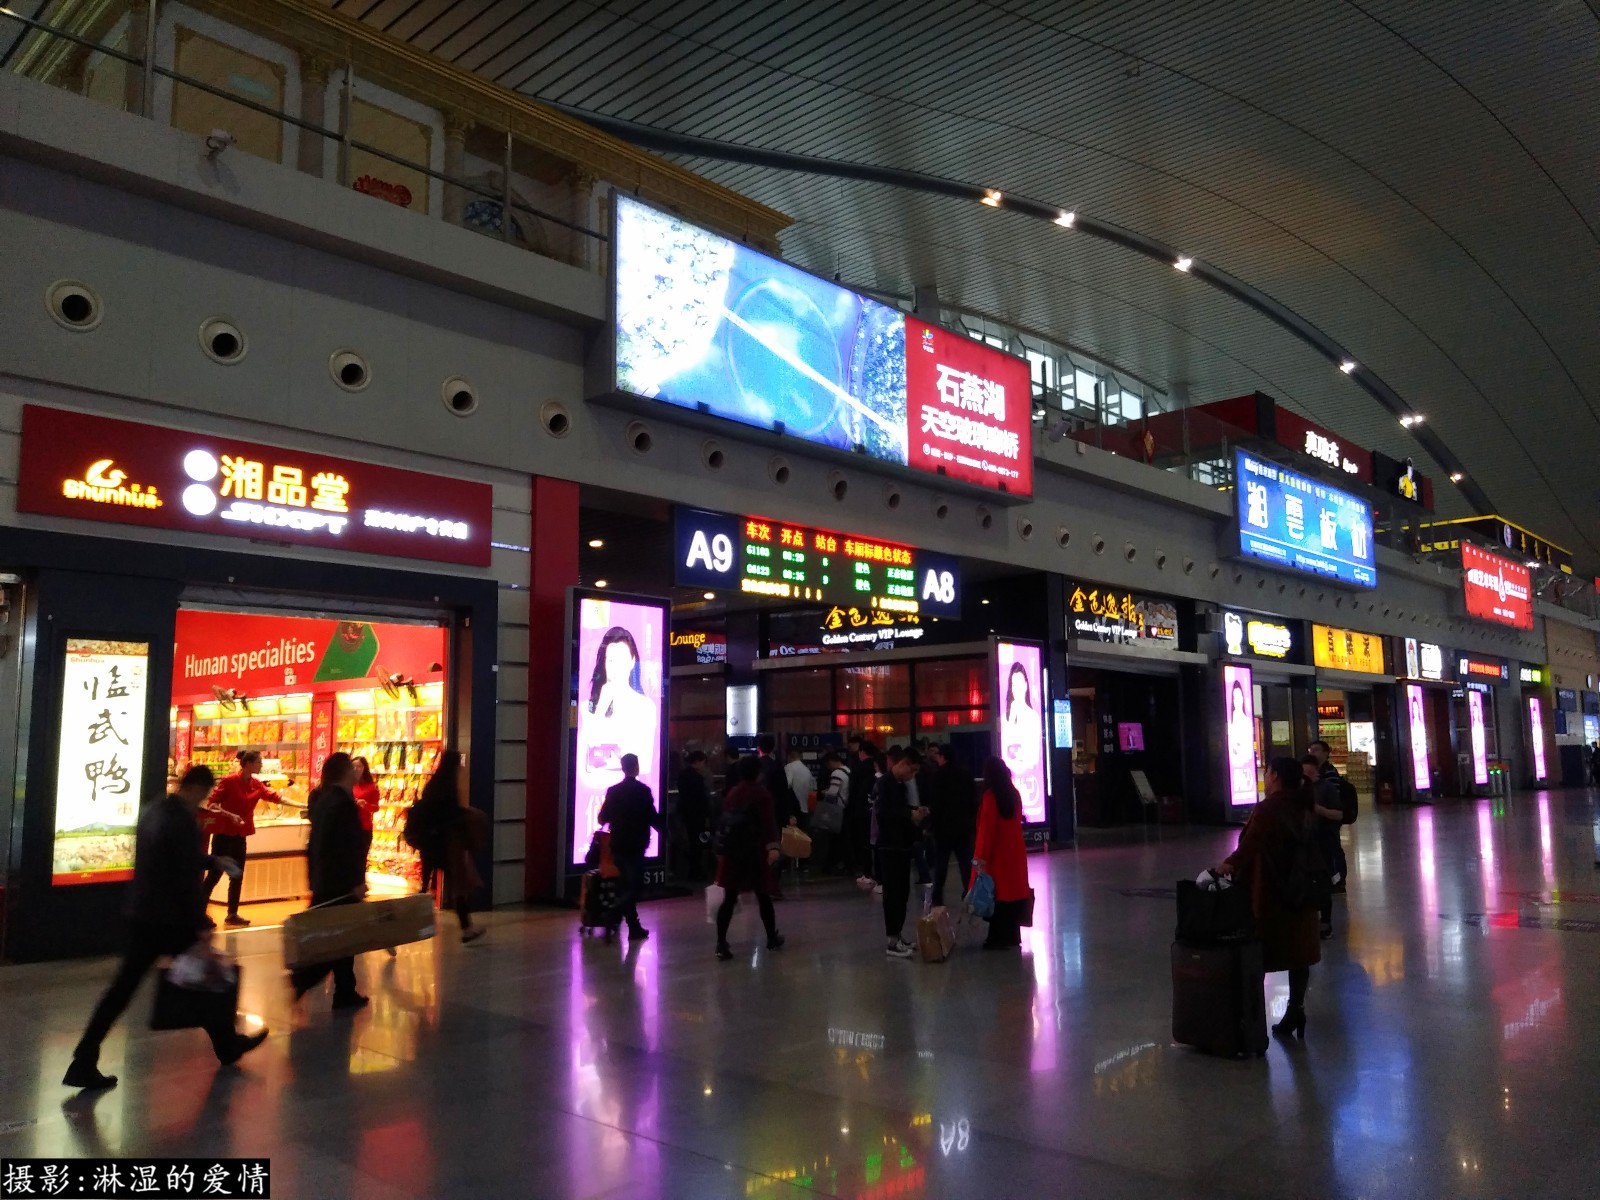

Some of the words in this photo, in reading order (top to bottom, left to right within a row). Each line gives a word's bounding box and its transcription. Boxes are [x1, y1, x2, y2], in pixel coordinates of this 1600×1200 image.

[936, 363, 1006, 422] 石燕湖
[219, 454, 350, 514] 湘品堂
[685, 530, 733, 573] A9
[746, 521, 770, 541] 车次
[781, 528, 804, 547] 开点
[815, 534, 837, 553] 站台
[922, 568, 956, 604] A8
[670, 632, 706, 648] Lounge
[822, 634, 848, 645] Golden
[848, 632, 878, 643] Century
[878, 628, 895, 640] VIP
[894, 628, 924, 640] Lounge
[1074, 618, 1093, 631] Golden
[1111, 625, 1122, 636] VIP
[184, 654, 229, 679] Hunan
[230, 636, 316, 680] specialties
